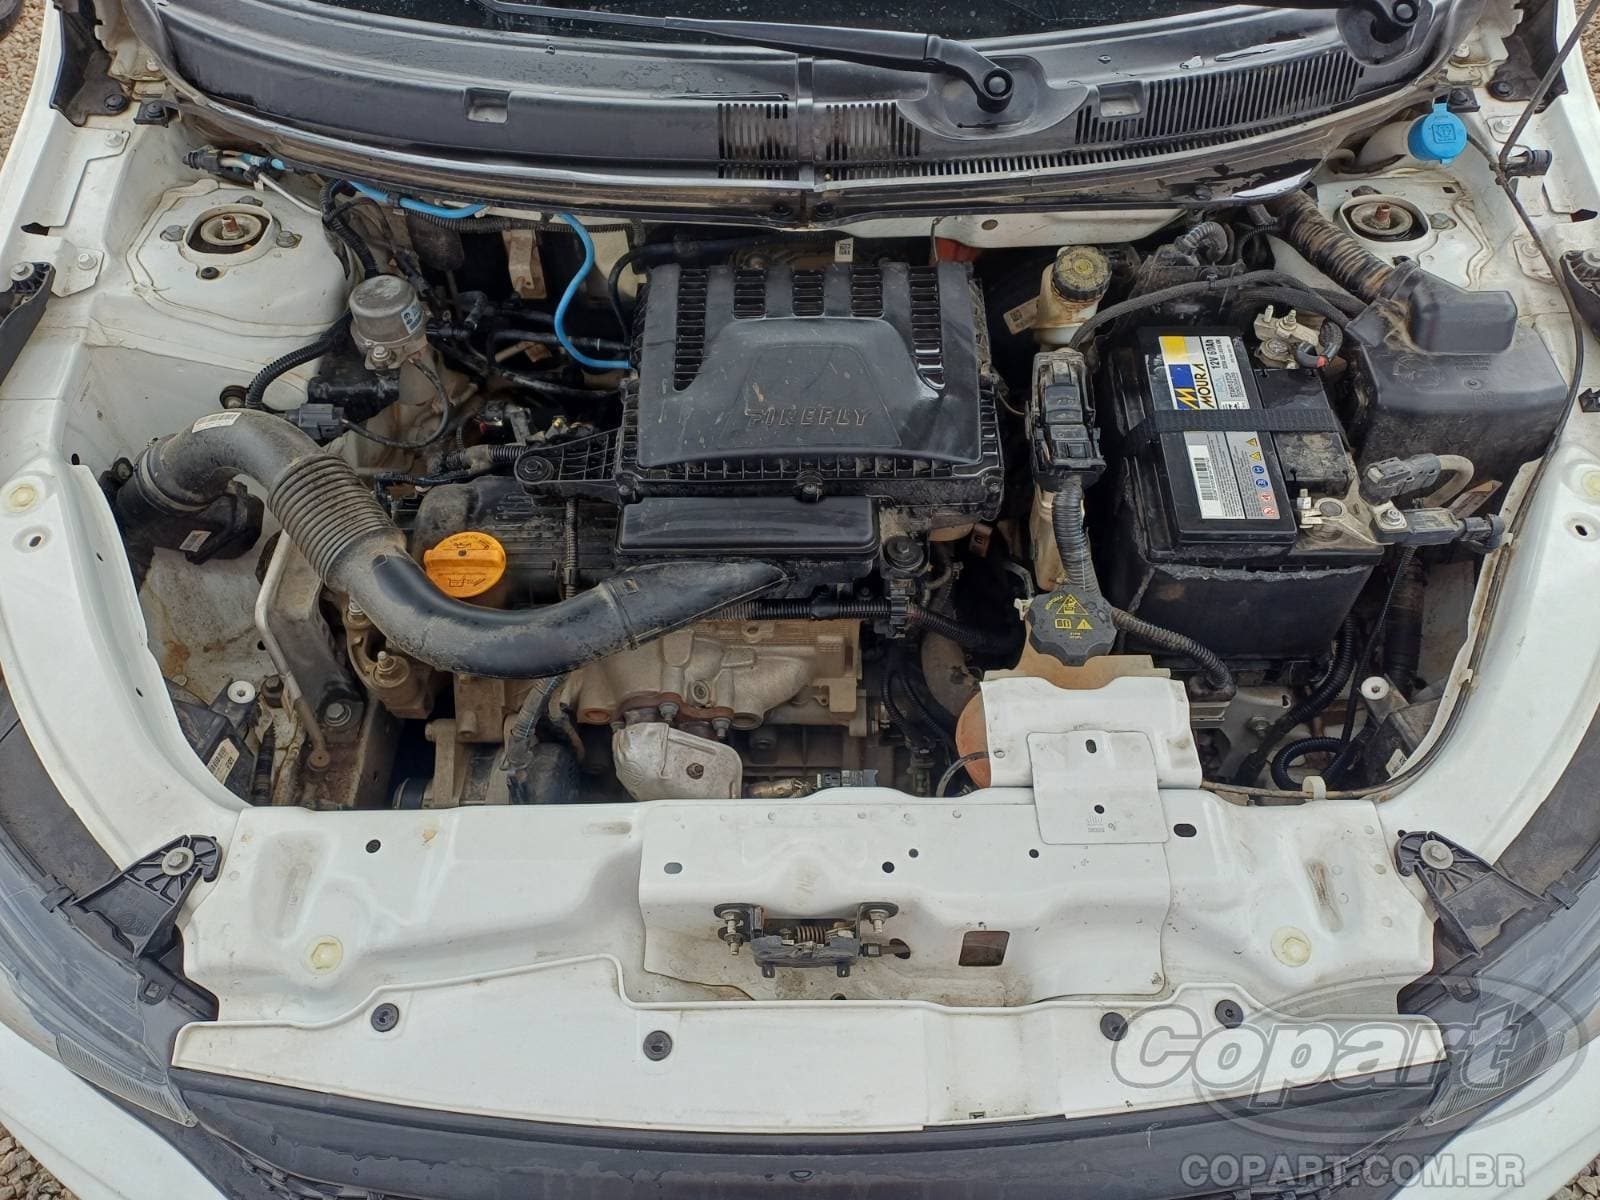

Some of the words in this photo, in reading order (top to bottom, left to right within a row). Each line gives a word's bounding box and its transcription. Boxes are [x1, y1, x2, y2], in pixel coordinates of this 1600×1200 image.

[1208, 356, 1221, 369] 12V
[1192, 363, 1215, 409] MOURA
[744, 406, 872, 426] FIREFLY
